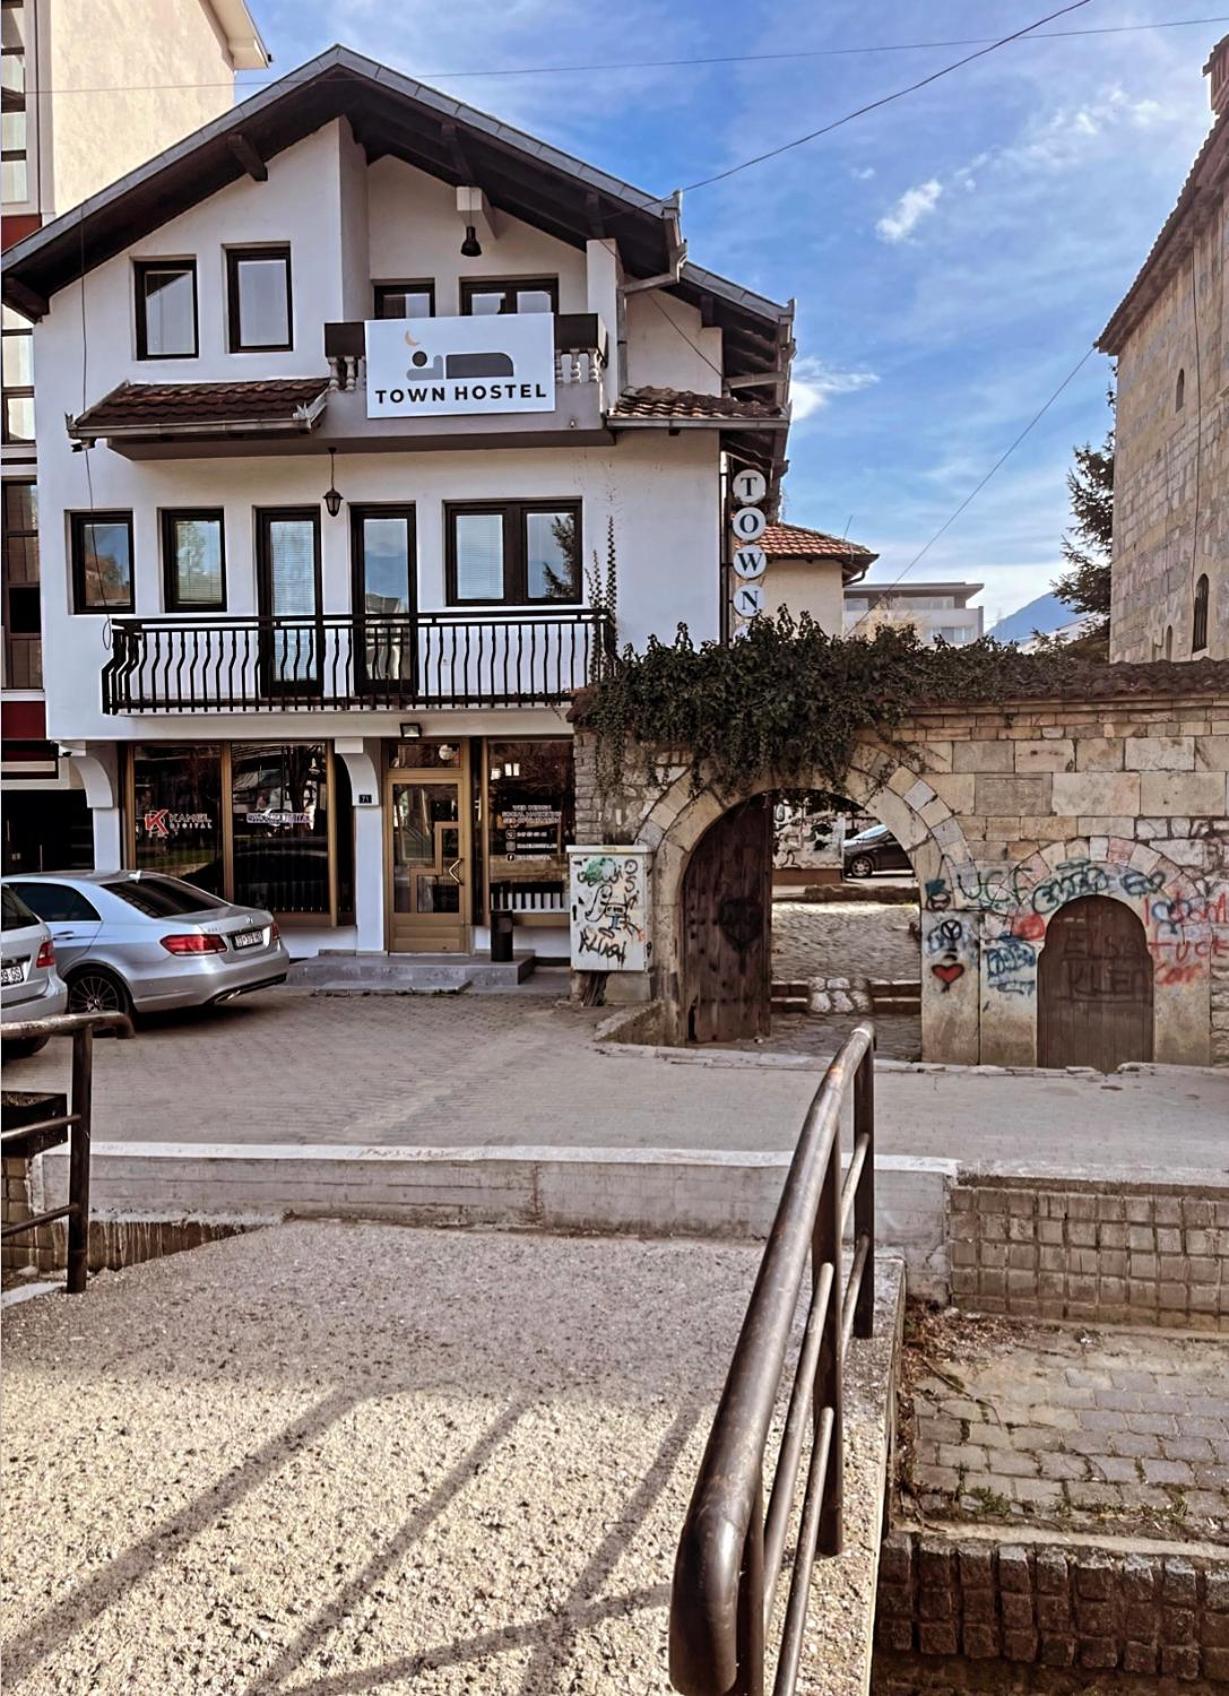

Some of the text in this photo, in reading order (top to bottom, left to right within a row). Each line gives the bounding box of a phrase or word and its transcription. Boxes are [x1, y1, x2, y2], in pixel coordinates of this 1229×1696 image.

[375, 383, 547, 404] TOWN HOSTEL
[738, 477, 762, 612] TOWN
